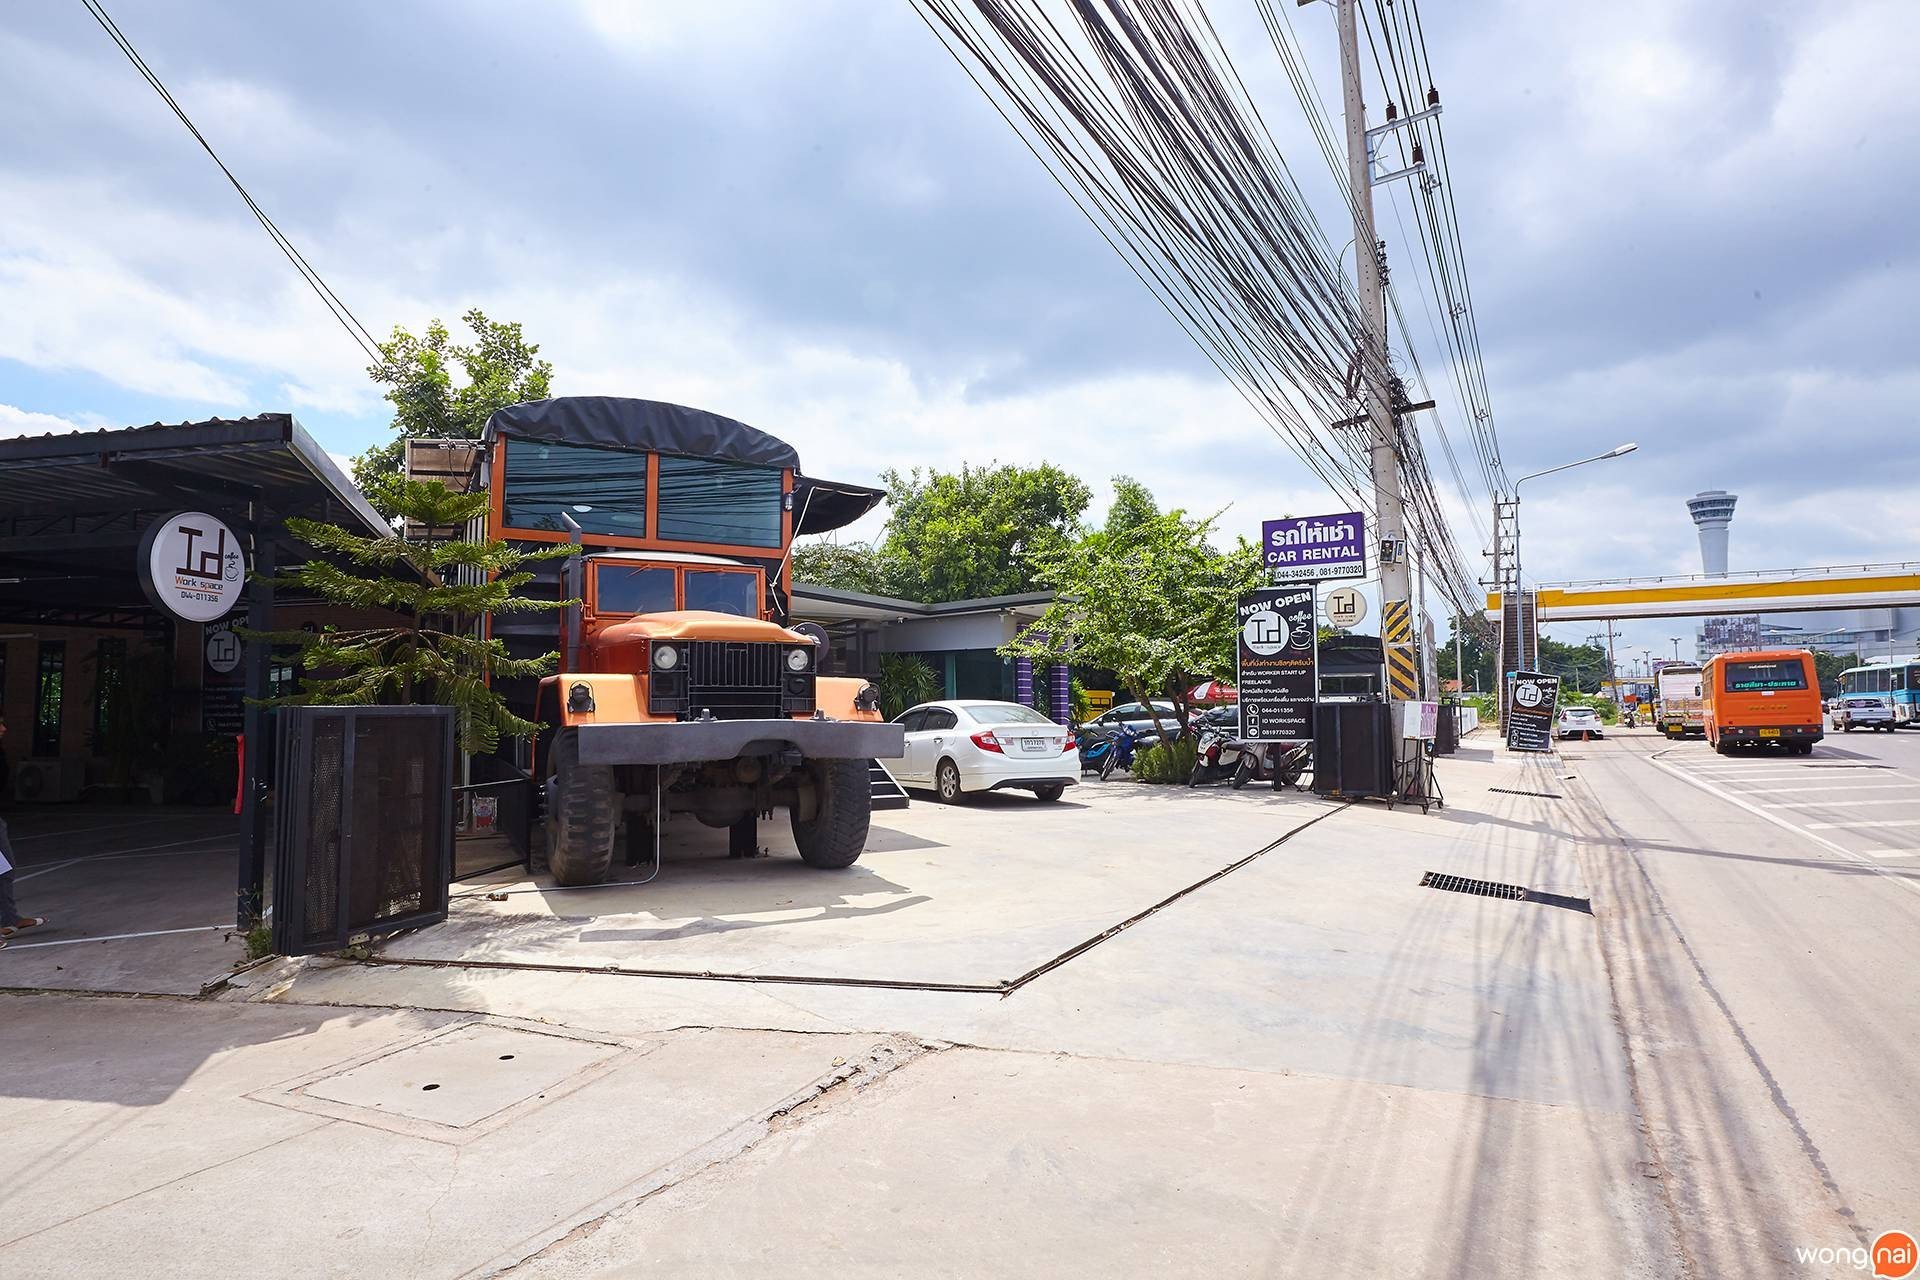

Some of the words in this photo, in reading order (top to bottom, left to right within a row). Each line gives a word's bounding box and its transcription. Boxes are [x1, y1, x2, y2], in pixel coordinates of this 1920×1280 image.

[1271, 520, 1355, 547] รถให้เช่า
[1267, 550, 1297, 563] CAR
[1302, 545, 1360, 561] RENTAL
[1319, 565, 1362, 577] 081-9770320
[175, 575, 197, 588] Work
[200, 581, 224, 592] space
[180, 590, 219, 603] 044-011356
[1240, 600, 1272, 616] NOW
[1274, 591, 1312, 608] OPEN
[1288, 610, 1313, 623] coffee
[205, 620, 230, 636] NOW
[1516, 678, 1536, 686] NOW
[1536, 677, 1558, 685] OPEN
